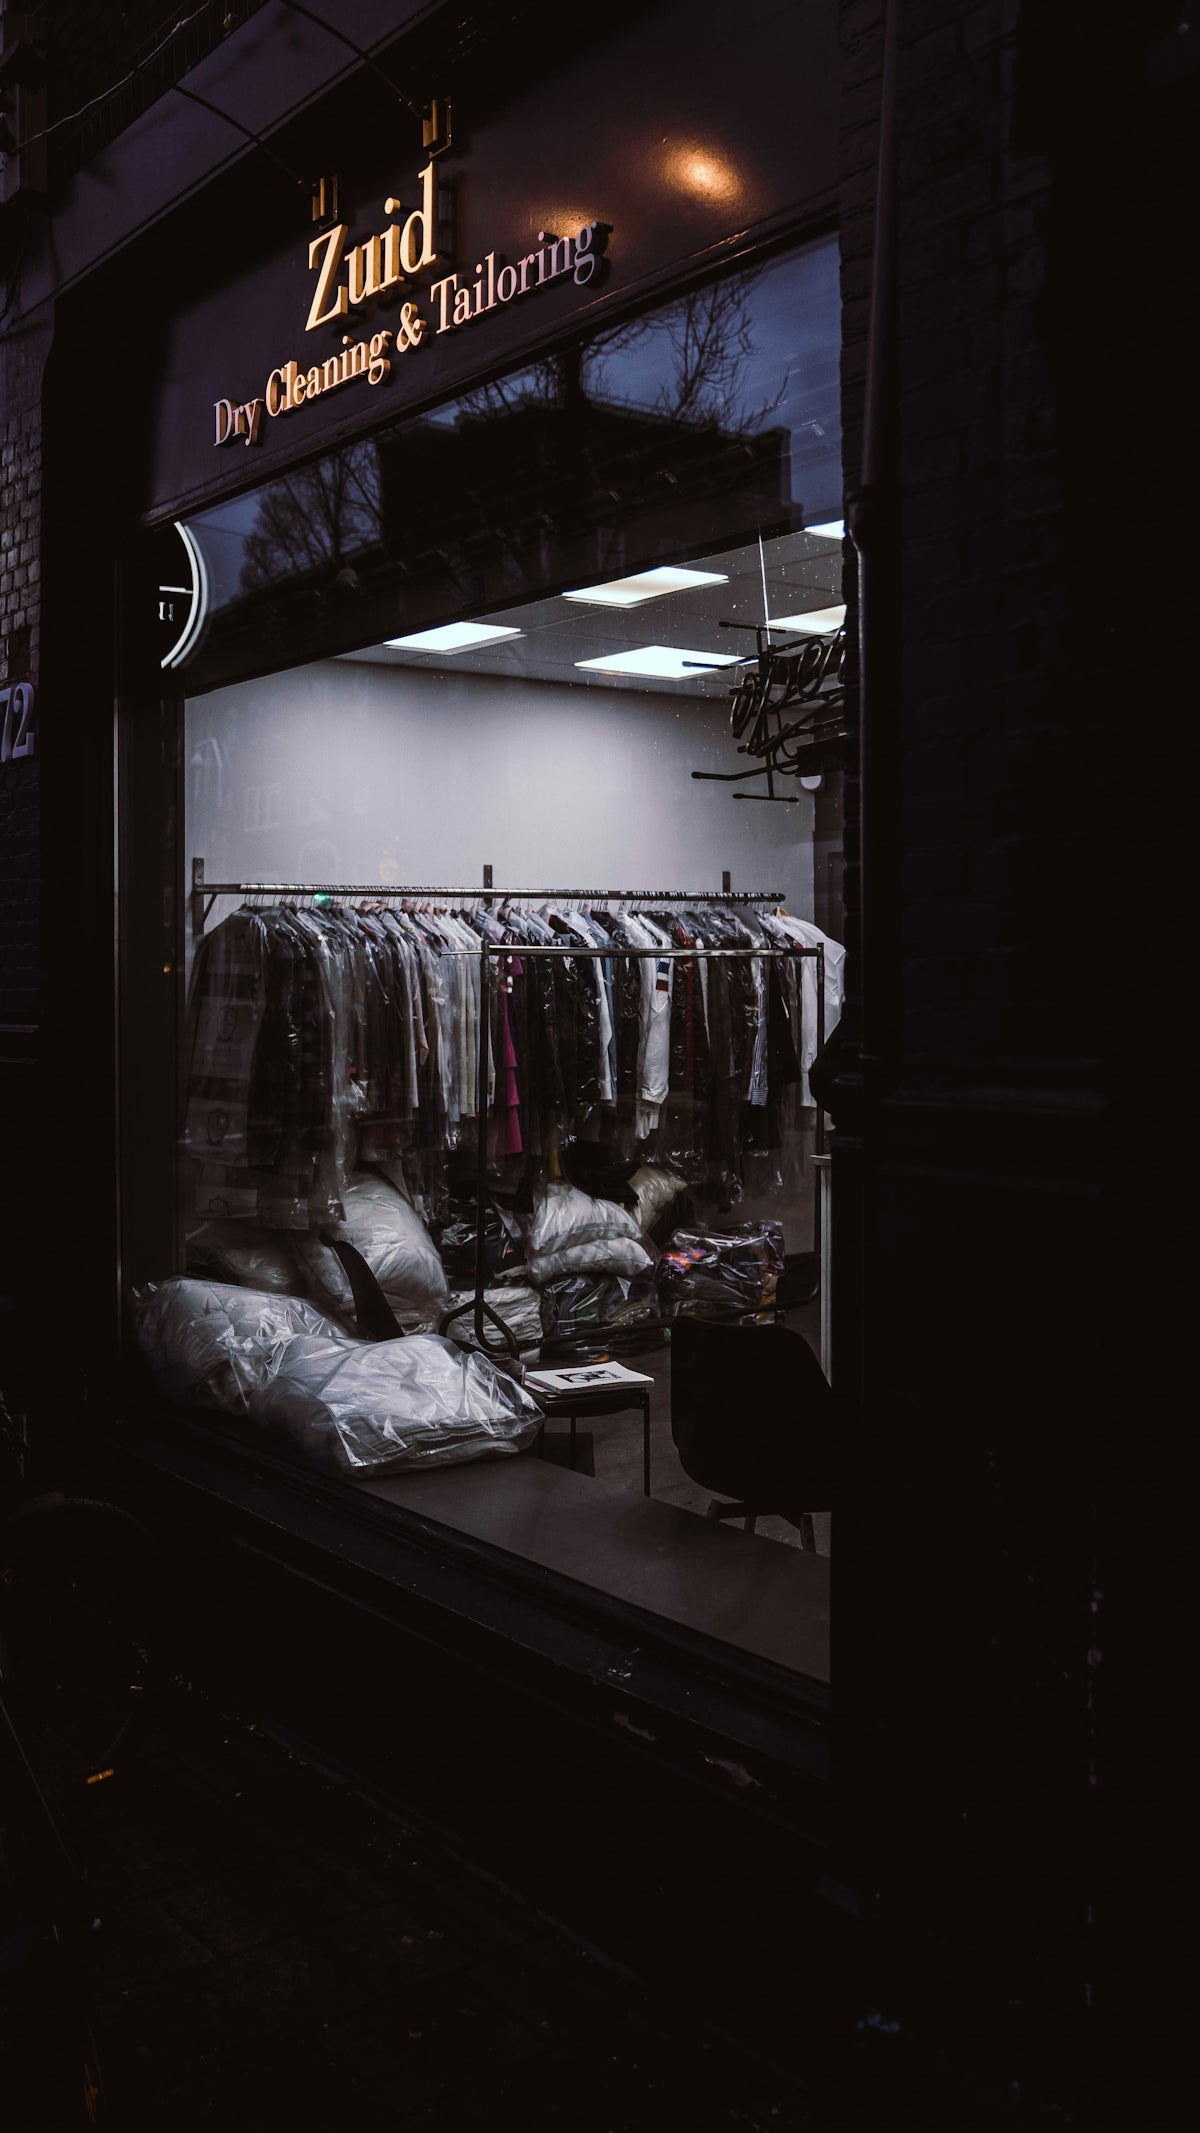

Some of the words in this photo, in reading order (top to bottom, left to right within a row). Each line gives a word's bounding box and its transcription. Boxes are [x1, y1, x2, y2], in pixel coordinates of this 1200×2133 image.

[213, 397, 263, 447] Dry
[265, 330, 392, 417] Cleaning
[396, 302, 427, 353] &
[430, 221, 598, 334] Tailoring
[305, 161, 437, 331] Zuid
